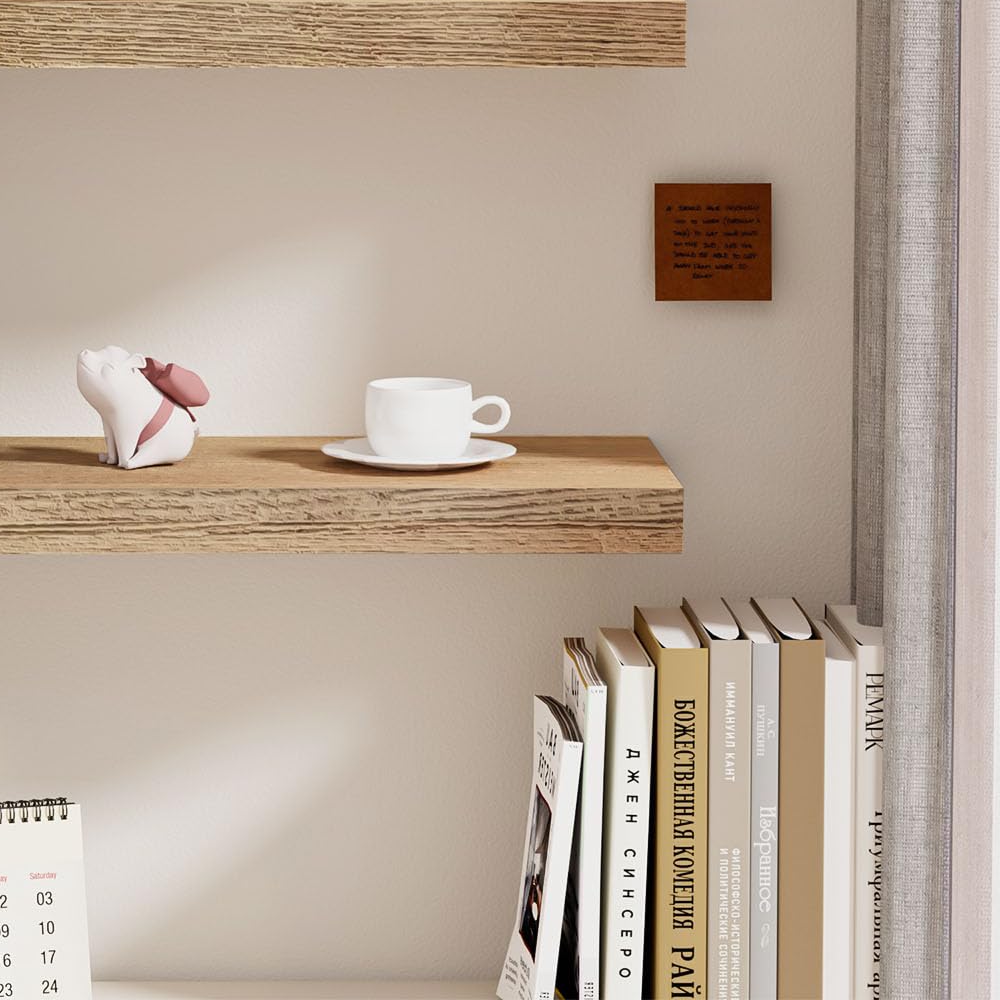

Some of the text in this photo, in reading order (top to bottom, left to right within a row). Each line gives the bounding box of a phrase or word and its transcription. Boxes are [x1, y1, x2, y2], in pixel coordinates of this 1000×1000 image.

[724, 682, 736, 783] ИММАНУИЛ КАНТ
[756, 704, 766, 758] ПУШКИН
[864, 671, 885, 752] РЕМАРК
[29, 871, 57, 880] Saturday
[618, 748, 641, 979] ДЖЕН СИНСЕРО
[669, 699, 702, 999] БОЖЕСТВЕННАЯ КОМЕДИЯ РАЙ
[719, 847, 729, 855] И
[754, 805, 778, 913] Избранное
[36, 891, 54, 906] 03
[718, 858, 729, 941] ПОЛИТИЧЕСКИЕ
[39, 920, 55, 935] 10
[41, 950, 56, 965] 17
[42, 979, 58, 994] 24
